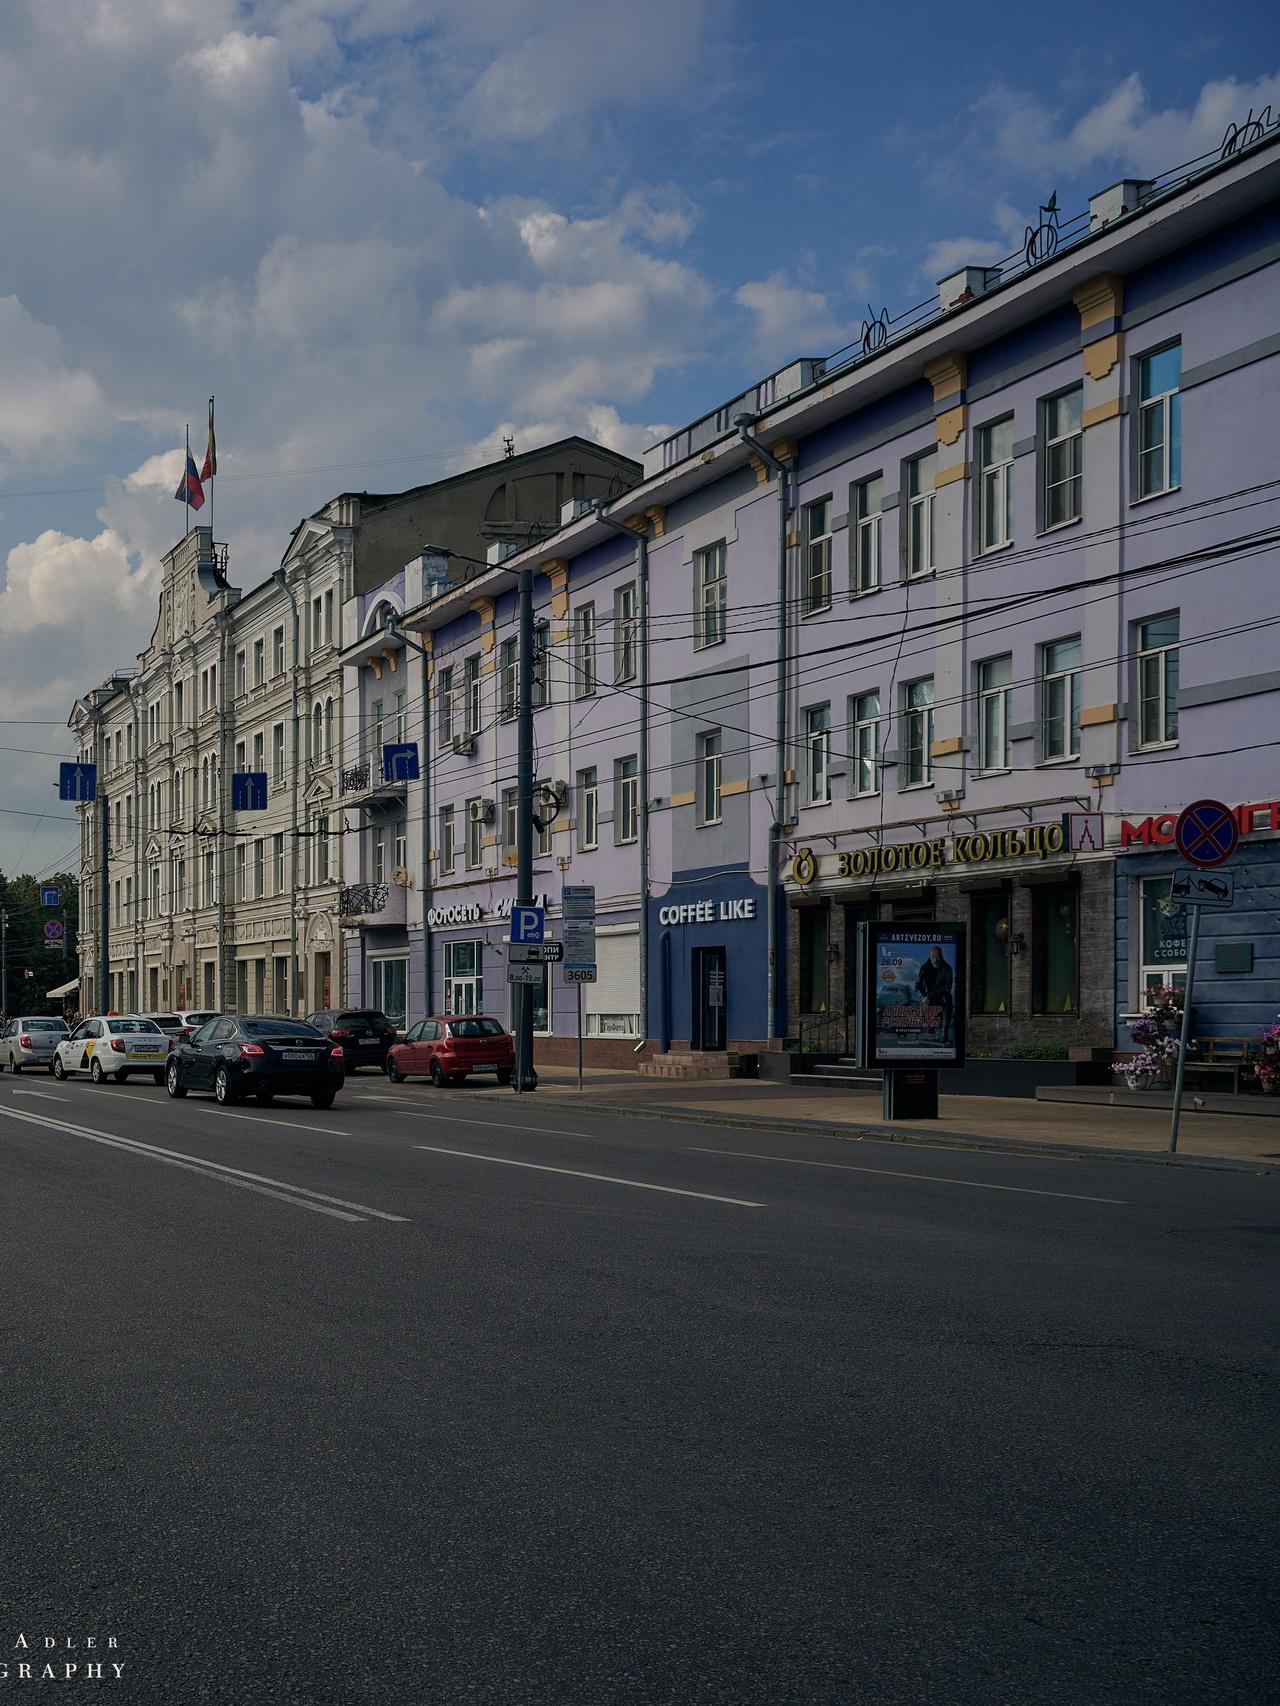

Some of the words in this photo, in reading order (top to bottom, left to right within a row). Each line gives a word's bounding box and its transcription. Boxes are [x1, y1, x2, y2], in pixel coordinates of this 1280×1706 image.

[838, 838, 946, 877] ЗОЛОТОЕ
[951, 824, 1064, 863] КОЛЬЦО
[427, 904, 481, 926] ФОТОСЕТЬ
[659, 903, 715, 926] COFFEE
[720, 899, 755, 921] LIKE
[891, 933, 942, 942] ARTZVEZDY.RU
[1159, 939, 1187, 948] КОФЕ
[1154, 950, 1160, 958] С
[880, 958, 903, 967] 26.09
[509, 974, 542, 983] 8.00-19.00
[568, 971, 593, 981] 3605
[882, 1005, 943, 1017] АЛЕКСАНДР
[881, 1016, 942, 1028] РОЗЕНБАУМ
